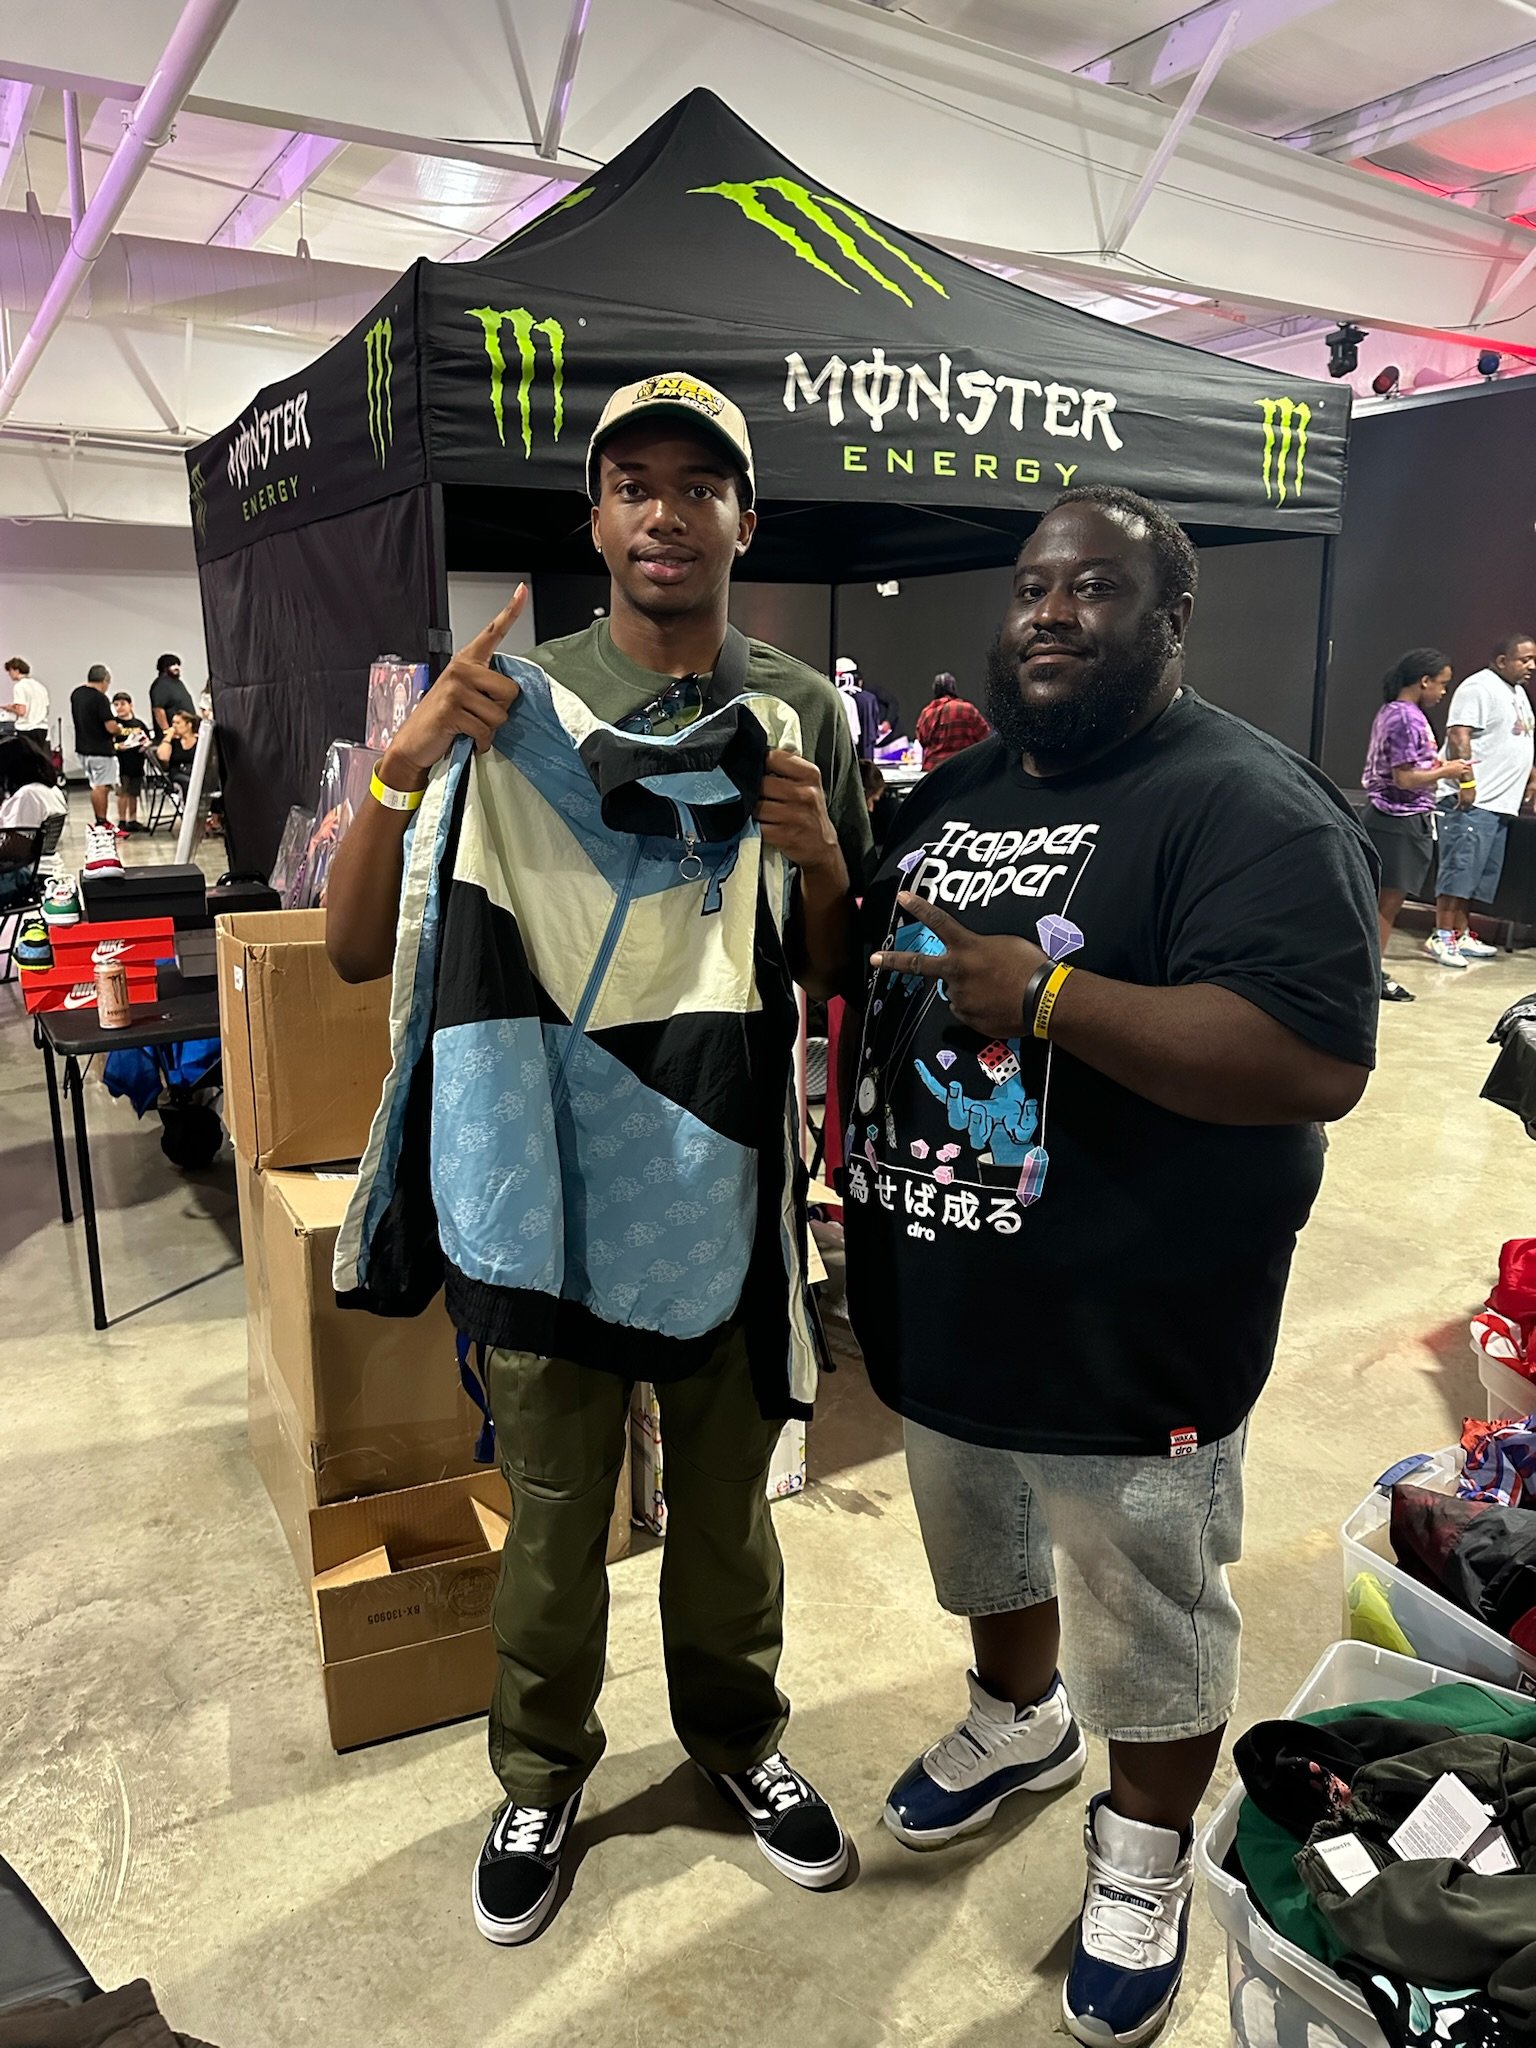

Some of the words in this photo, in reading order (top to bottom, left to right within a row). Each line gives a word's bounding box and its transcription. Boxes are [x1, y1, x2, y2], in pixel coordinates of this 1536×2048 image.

[657, 379, 714, 403] NBA
[783, 347, 1124, 452] MONSTER
[227, 390, 311, 490] MONSTER
[842, 445, 1079, 487] ENERGY
[242, 474, 298, 521] ENERGY
[931, 820, 1100, 868] Trapper
[909, 857, 1069, 911] Rapper
[98, 939, 126, 954] NIKE
[71, 982, 98, 998] NIK
[1040, 993, 1055, 1030] HORNETS
[849, 1162, 1022, 1234] 為せば成る
[907, 1221, 936, 1242] dro
[1175, 1446, 1192, 1455] dro
